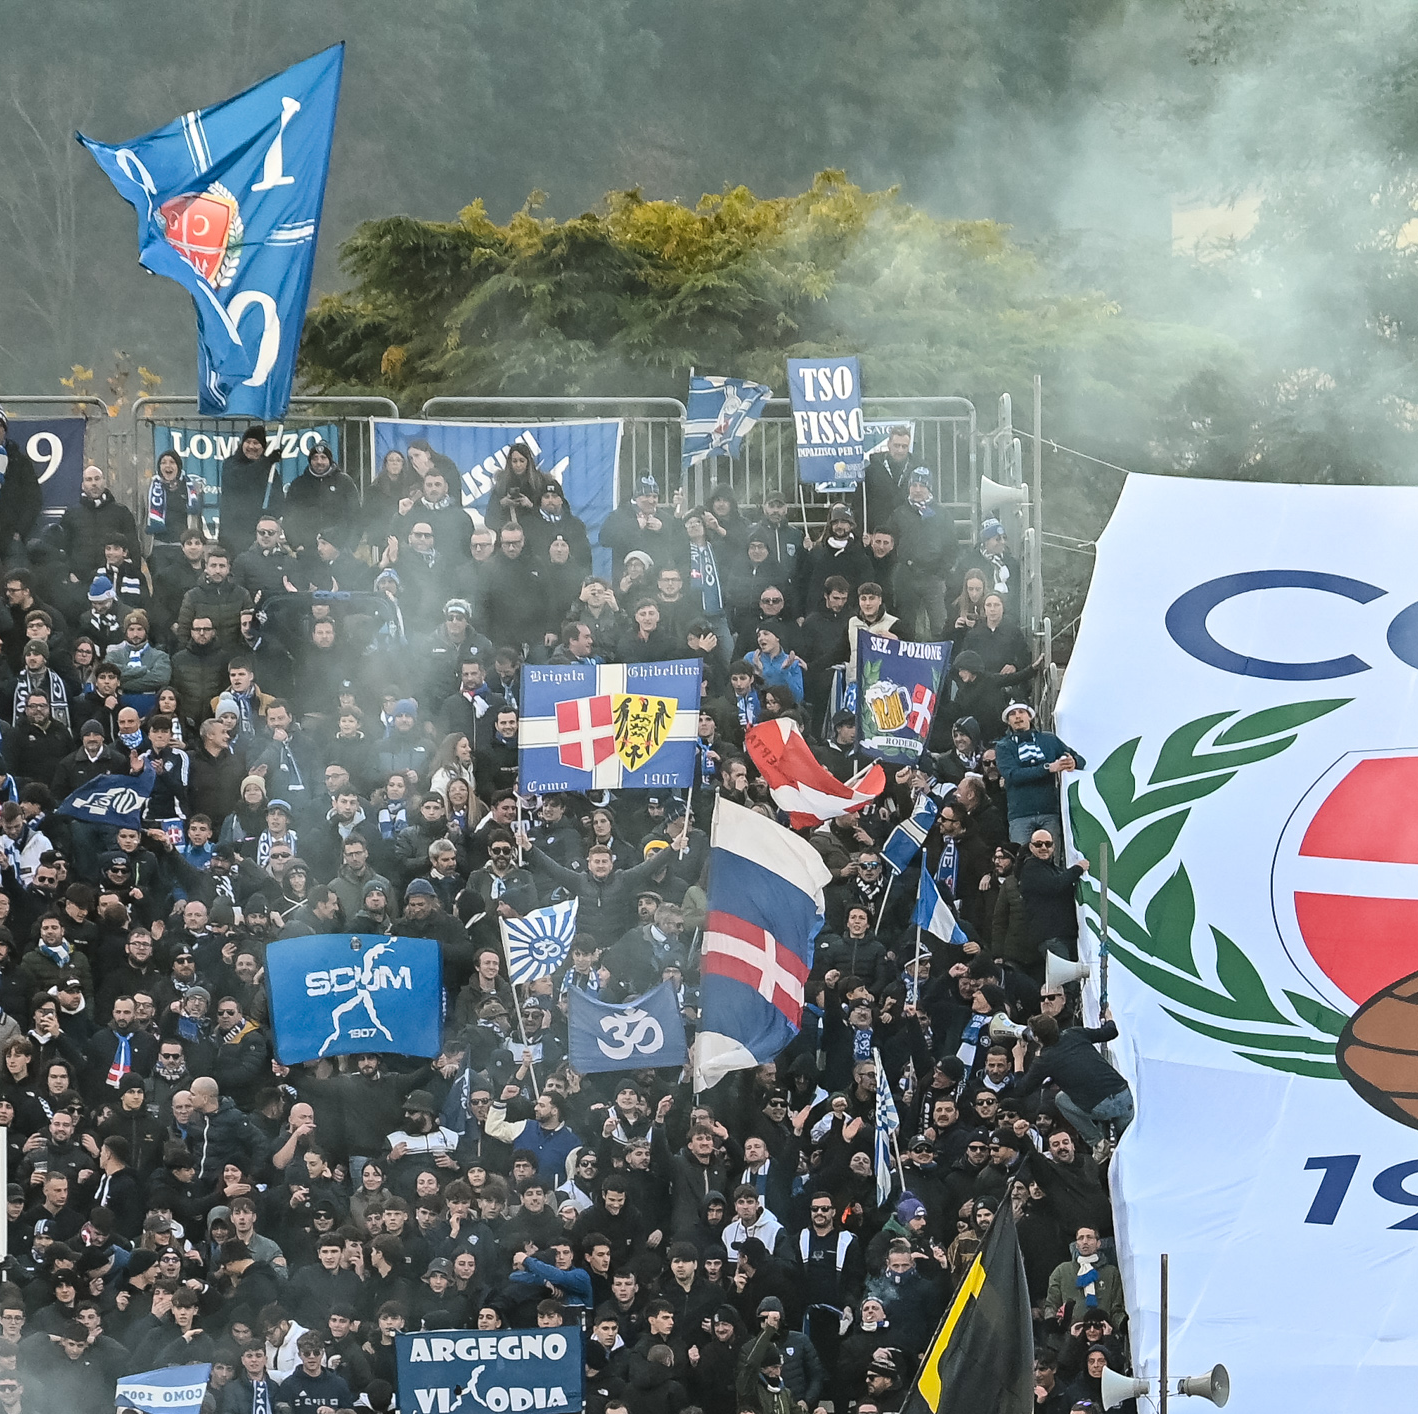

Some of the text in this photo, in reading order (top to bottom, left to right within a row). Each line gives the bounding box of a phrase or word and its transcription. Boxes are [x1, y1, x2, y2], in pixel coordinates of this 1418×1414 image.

[799, 366, 853, 402] TSO
[793, 407, 863, 445] FISSO
[26, 431, 64, 484] 9
[171, 430, 323, 460] LOMZZO
[870, 635, 943, 661] SEZ. POZIONE
[885, 737, 918, 750] RODERO
[526, 772, 680, 793] Como 1907
[304, 965, 413, 998] SCUM
[348, 1028, 378, 1040] 1907
[410, 1333, 568, 1363] ARGEGNO
